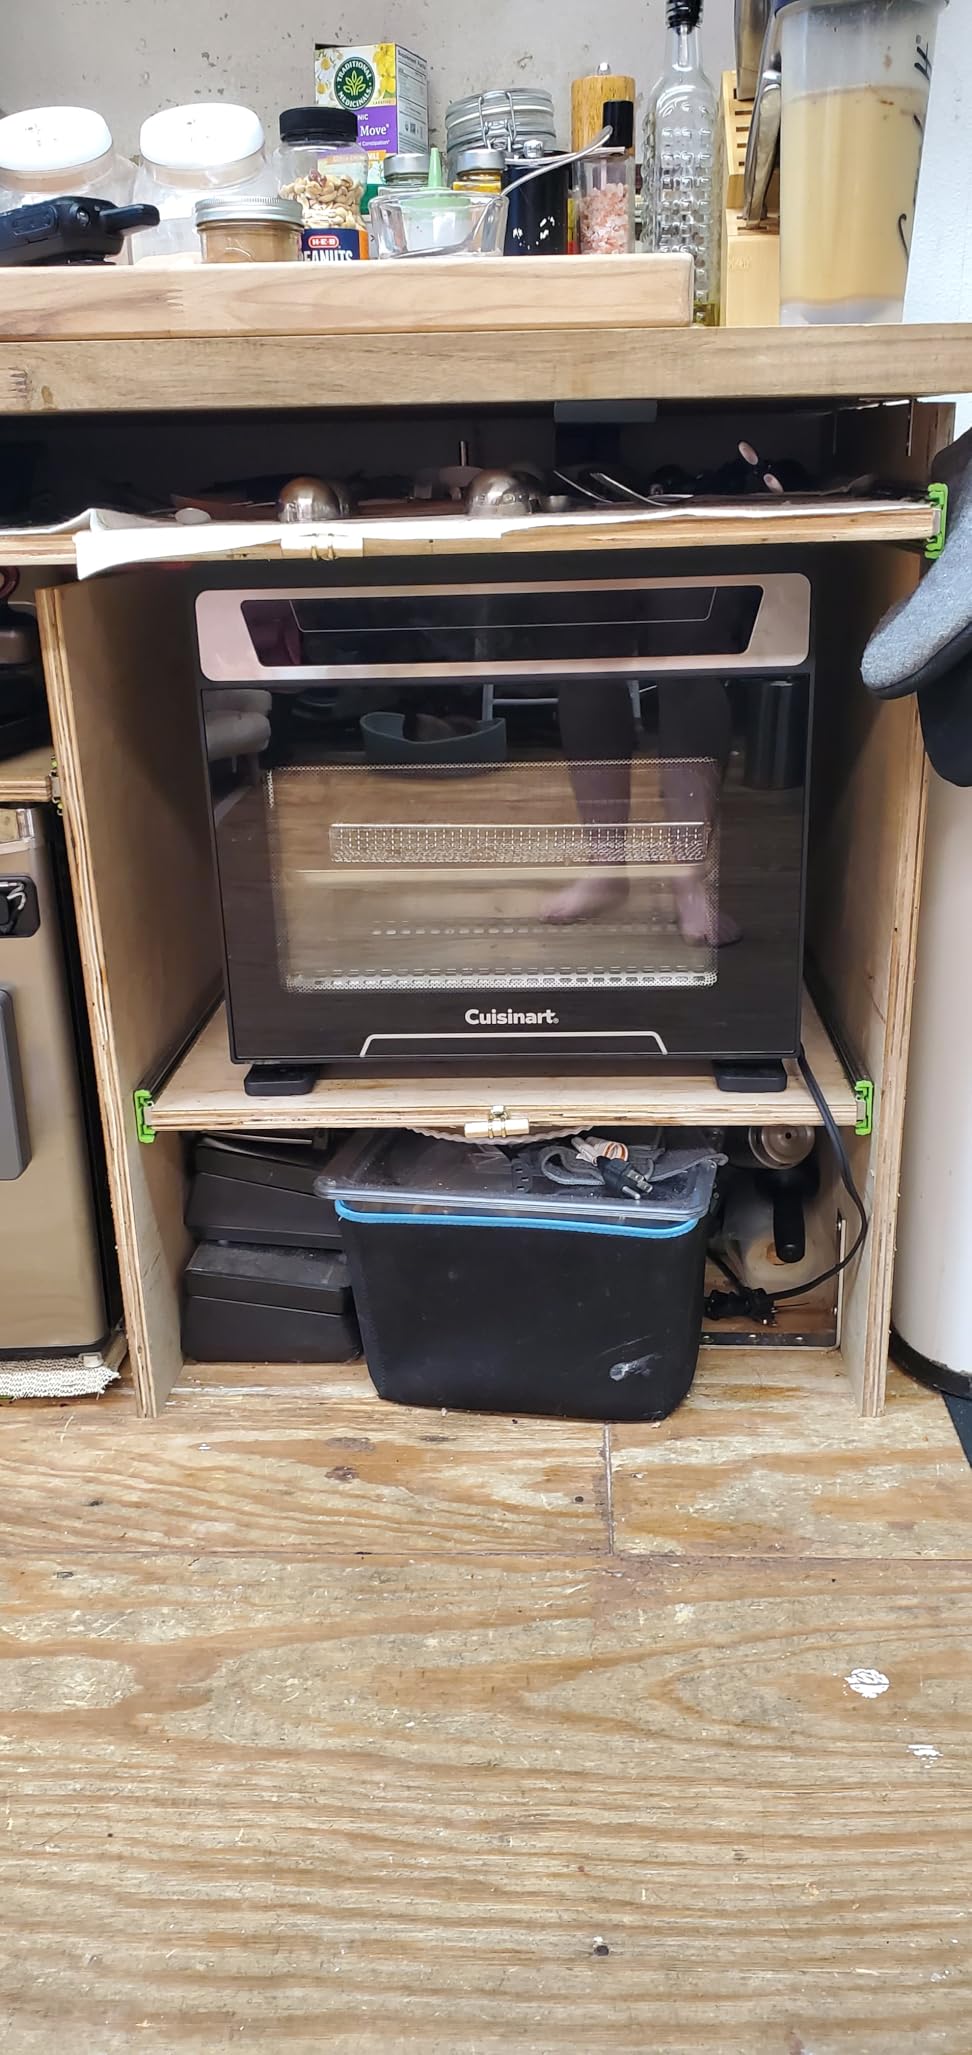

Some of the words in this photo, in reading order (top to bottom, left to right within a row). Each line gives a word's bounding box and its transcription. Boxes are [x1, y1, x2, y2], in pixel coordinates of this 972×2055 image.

[337, 61, 372, 83] TRADITIONAL
[357, 113, 369, 121] NIC
[303, 249, 353, 261] EANUTS
[464, 1008, 556, 1025] Cuisinart
